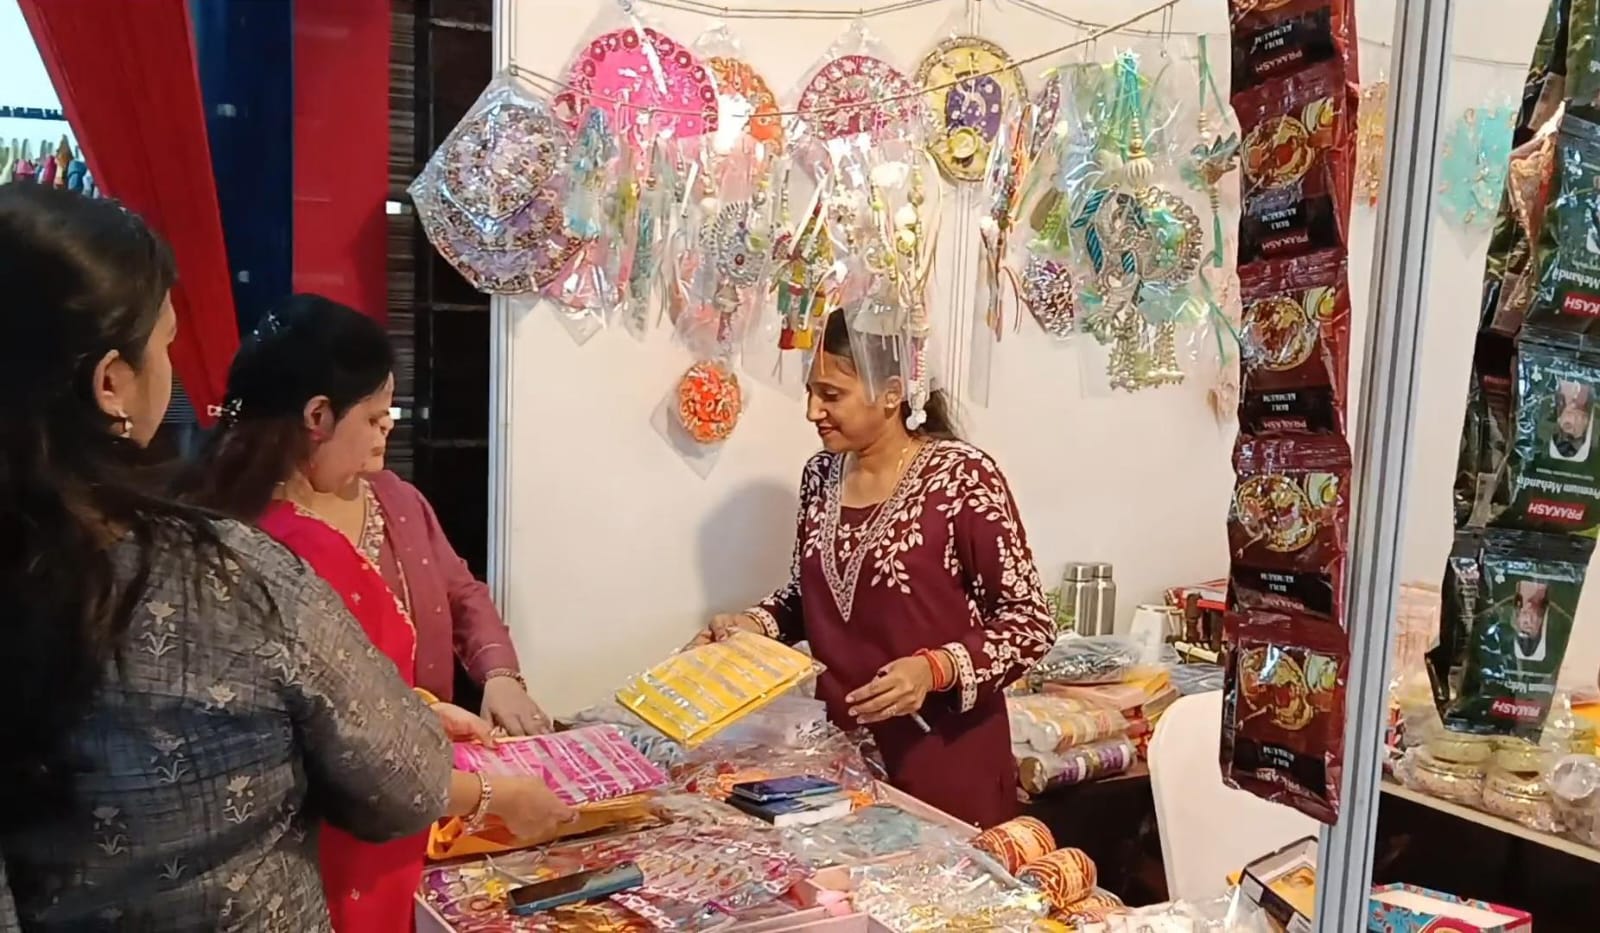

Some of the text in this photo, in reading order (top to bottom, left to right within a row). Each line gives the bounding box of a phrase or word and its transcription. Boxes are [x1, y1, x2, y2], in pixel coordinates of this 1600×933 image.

[1255, 50, 1303, 73] PRAKASH
[1261, 233, 1309, 251] PRAKASH
[1263, 419, 1307, 429] PRAKASH
[1528, 502, 1584, 521] PRAKASH
